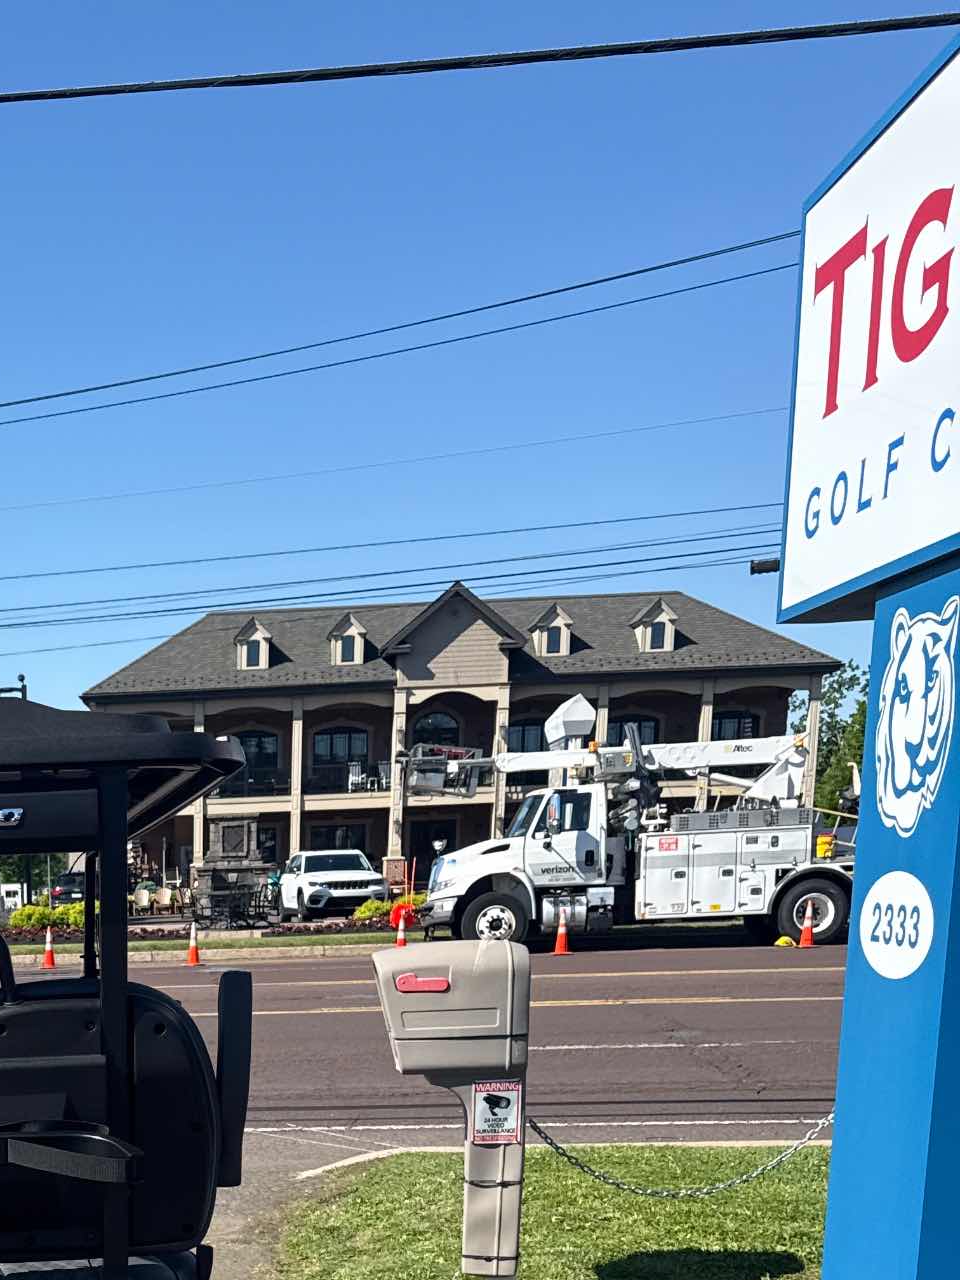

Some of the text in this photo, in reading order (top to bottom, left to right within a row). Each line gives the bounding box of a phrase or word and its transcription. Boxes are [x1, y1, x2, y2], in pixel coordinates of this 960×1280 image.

[804, 432, 905, 539] GOLF
[541, 864, 575, 874] verizon
[870, 902, 921, 949] 2333
[475, 1082, 519, 1091] WARNING
